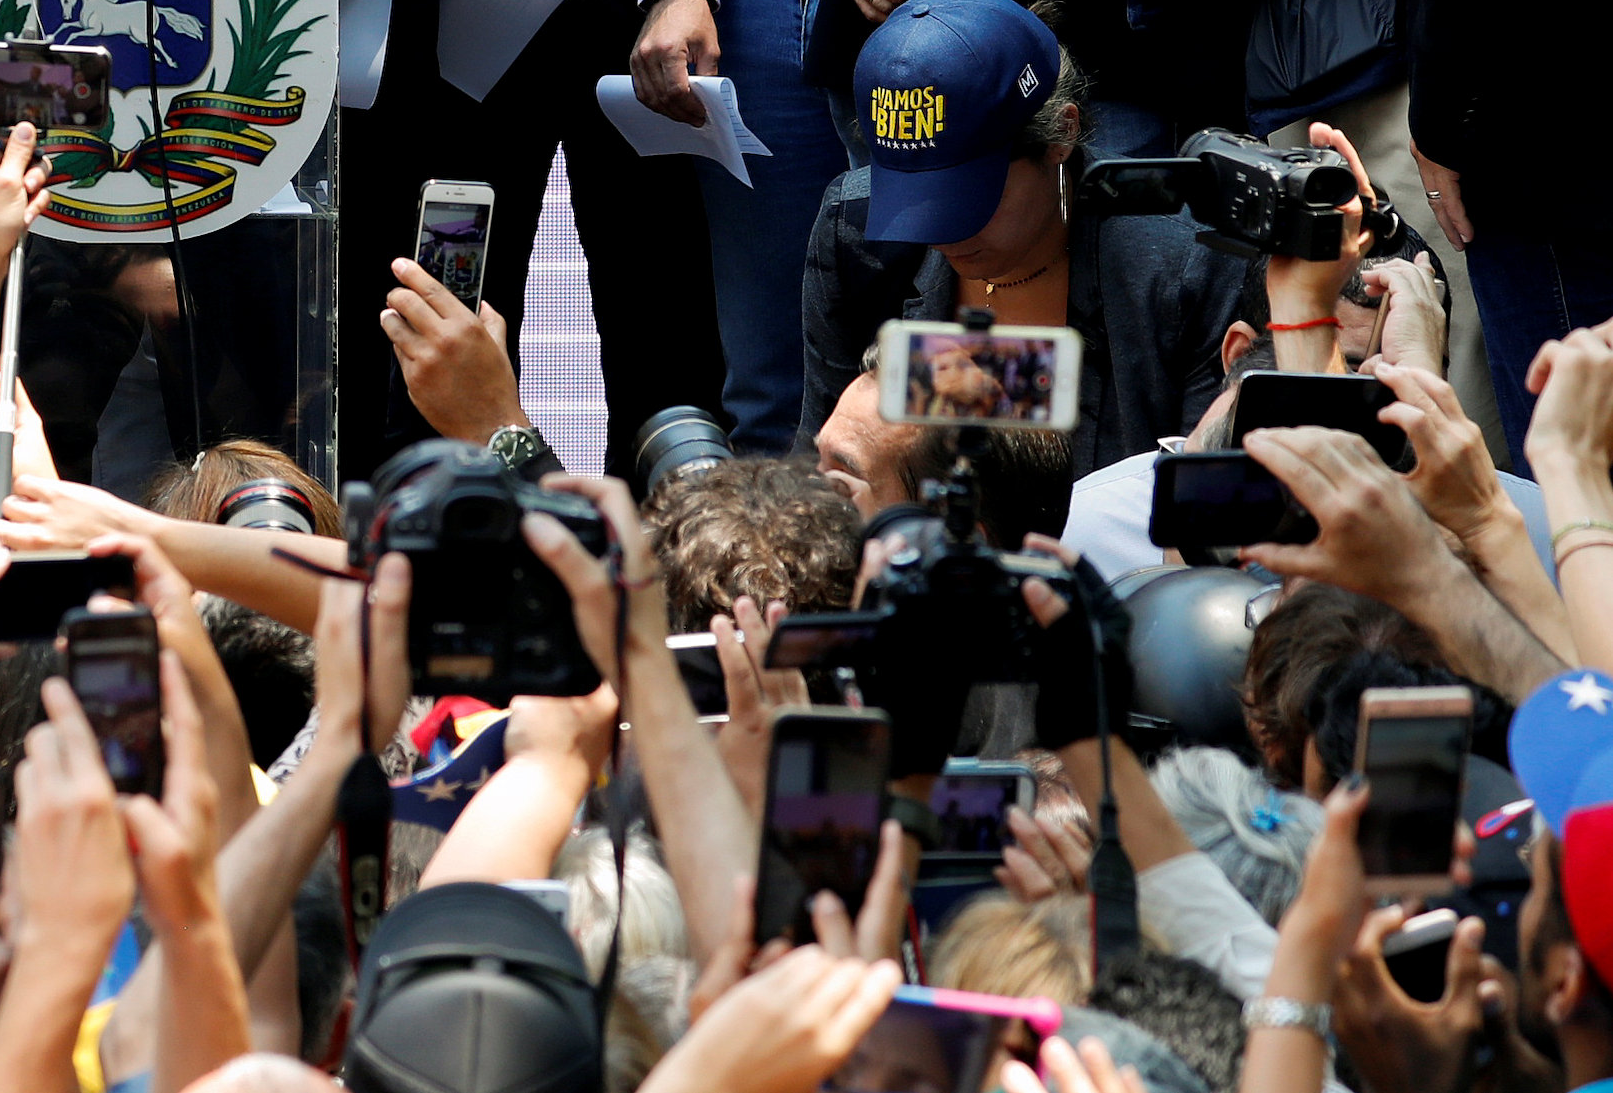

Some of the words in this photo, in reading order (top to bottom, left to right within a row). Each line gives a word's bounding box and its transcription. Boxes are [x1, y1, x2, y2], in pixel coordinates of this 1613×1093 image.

[192, 99, 206, 108] DE
[210, 99, 256, 115] FEBRERO
[260, 109, 273, 117] DE
[875, 94, 945, 141] BIEN!
[38, 136, 85, 145] NDENCIA
[80, 212, 148, 224] BOLIVARIANA
[151, 212, 164, 221] DE
[174, 191, 225, 216] ENEZUELA
